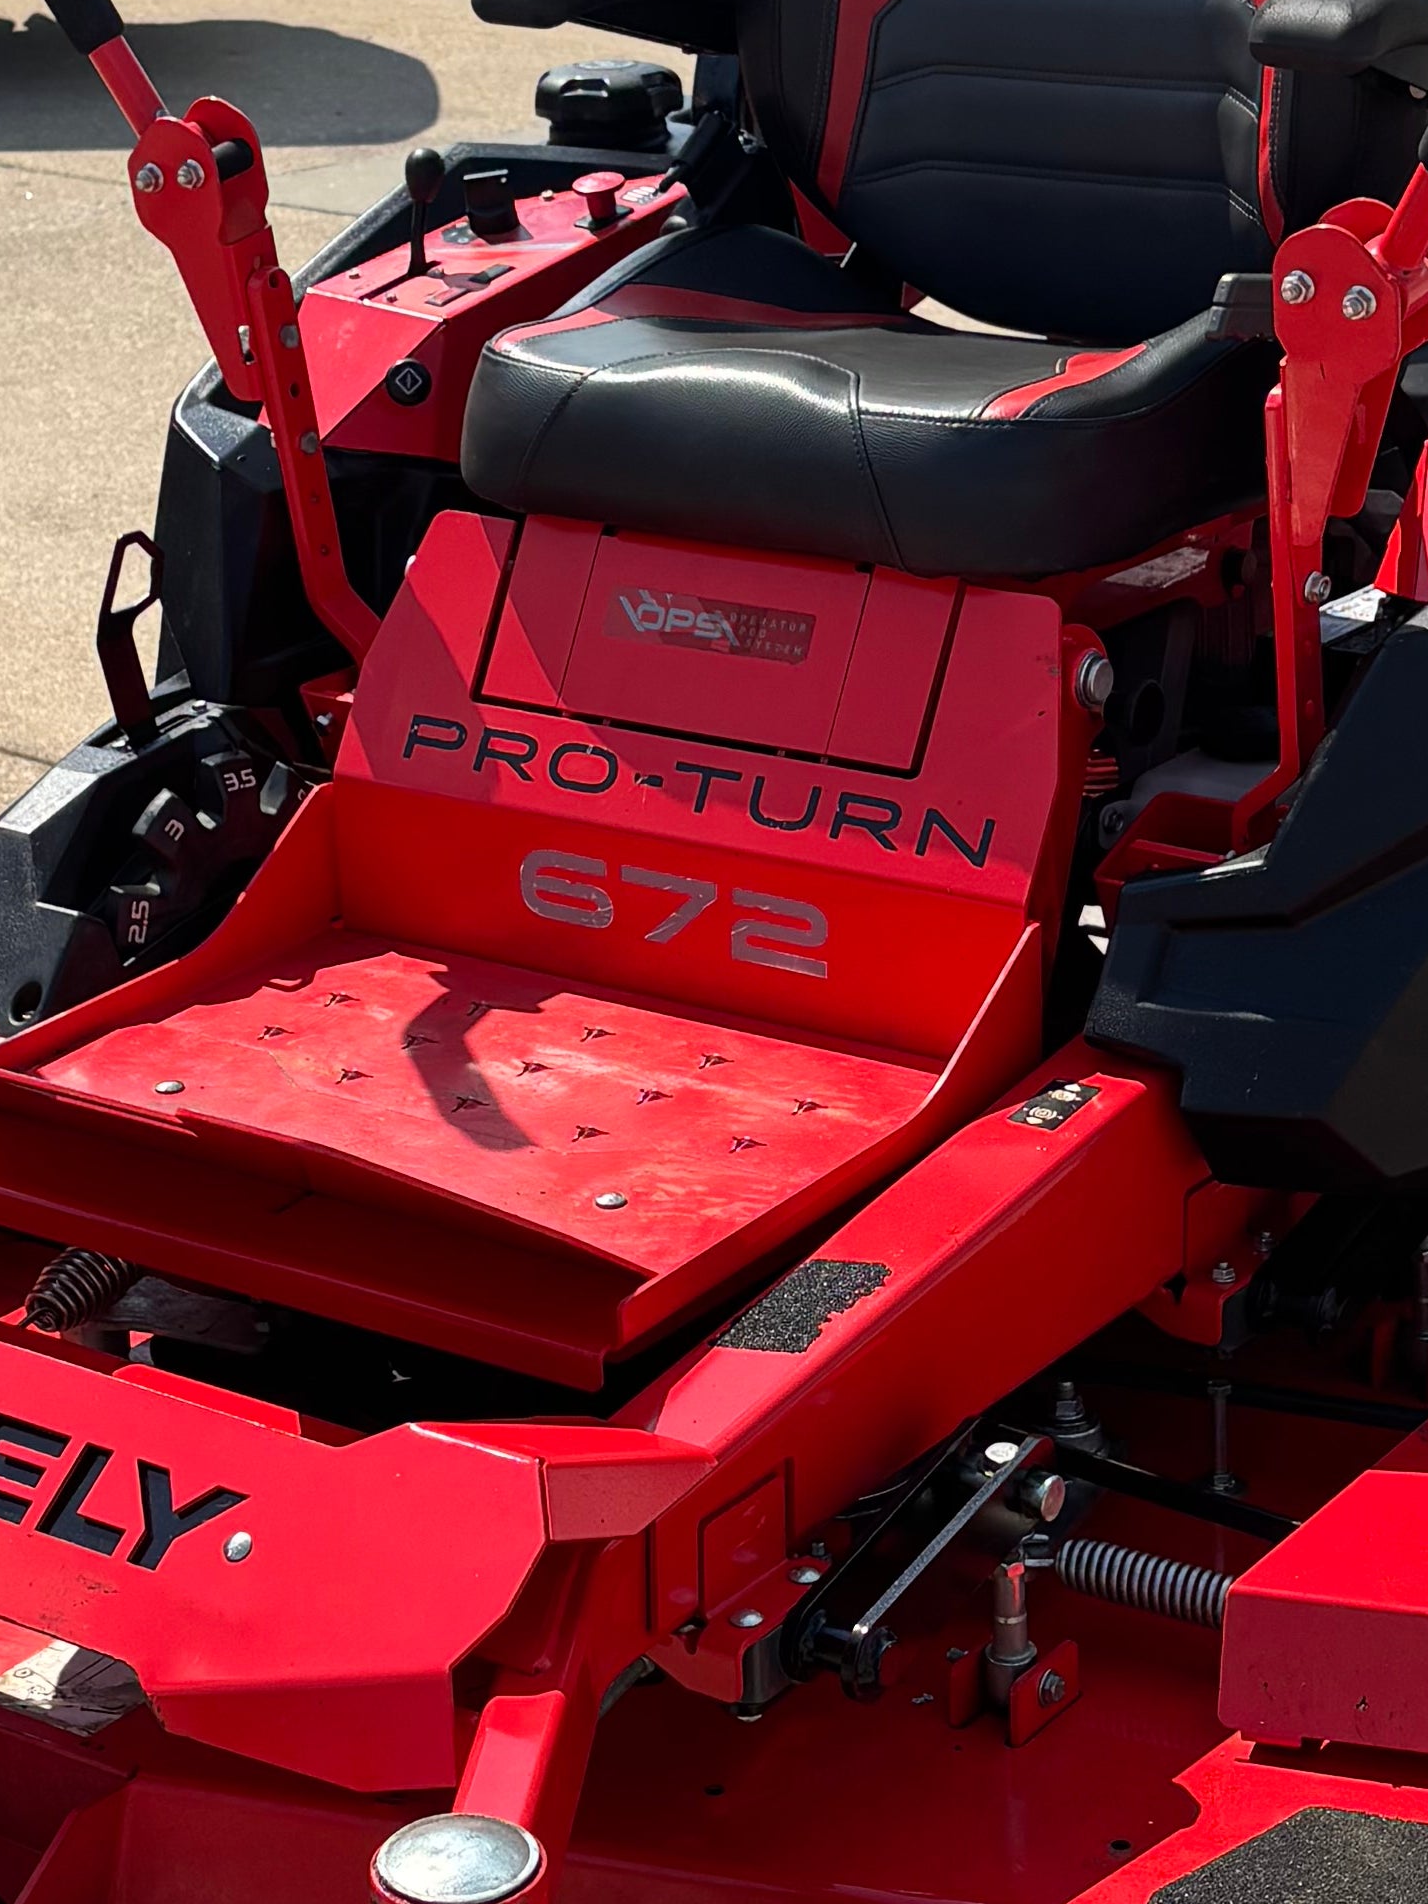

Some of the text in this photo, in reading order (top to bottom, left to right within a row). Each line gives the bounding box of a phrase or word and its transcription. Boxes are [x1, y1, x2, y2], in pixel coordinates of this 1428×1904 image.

[223, 768, 257, 792] 3.5
[403, 713, 997, 868] PRO-TURN
[164, 818, 185, 842] 3
[127, 900, 150, 944] 2.5
[519, 847, 829, 979] 672
